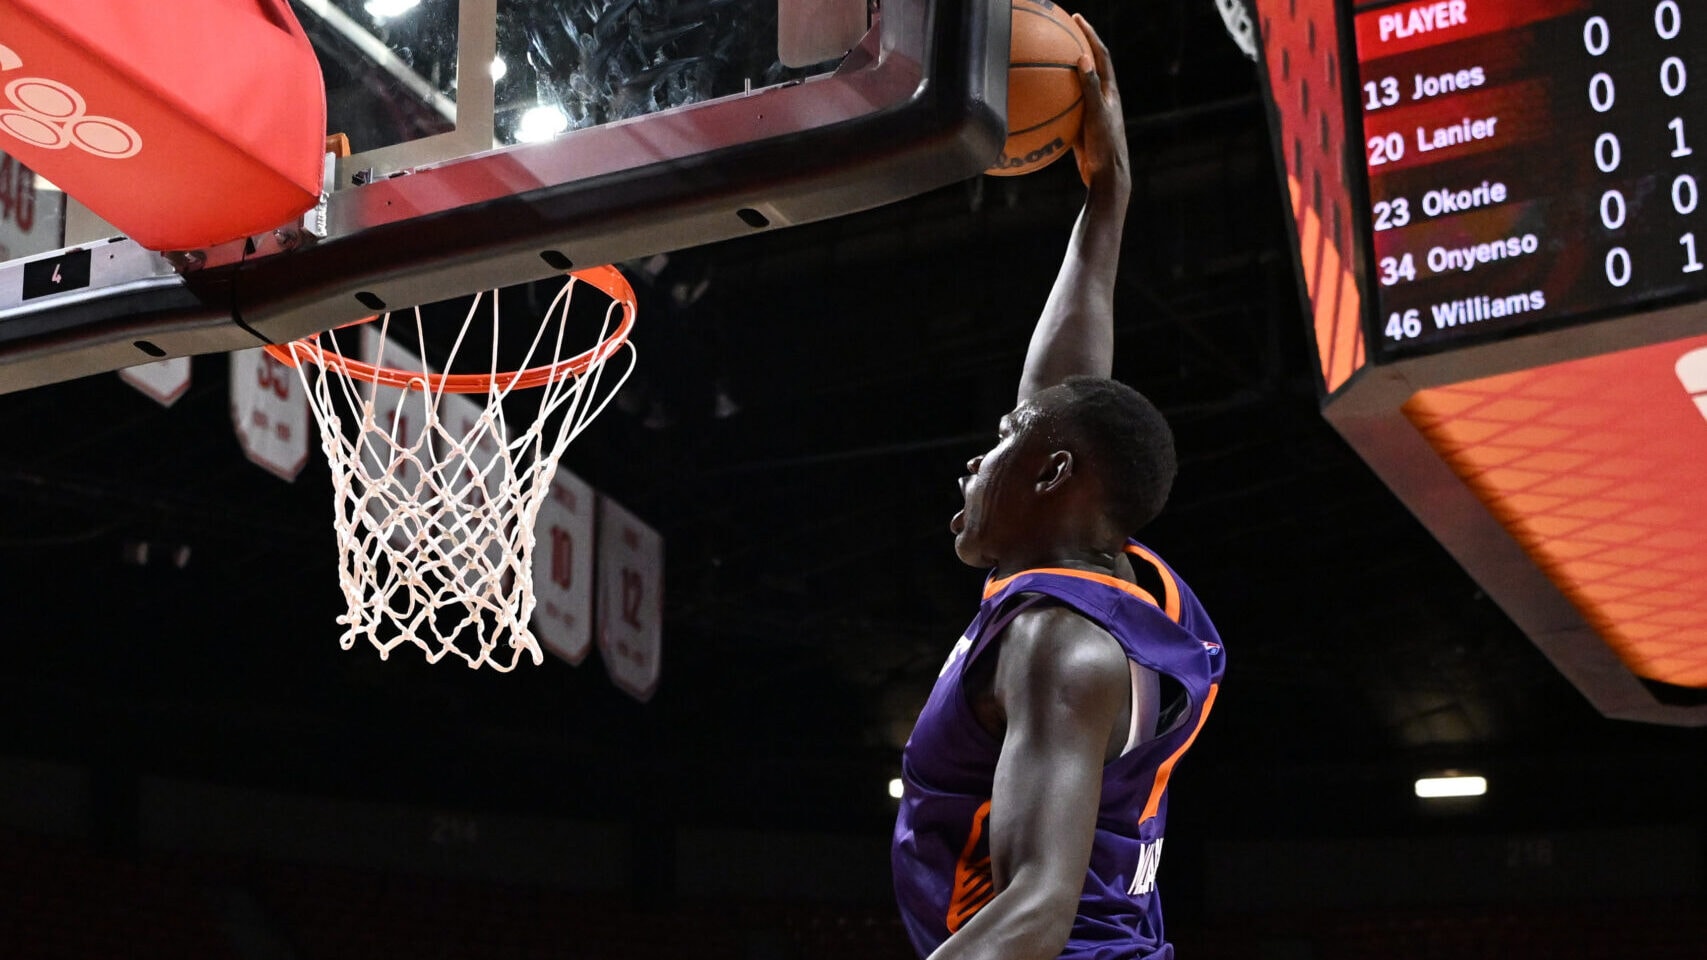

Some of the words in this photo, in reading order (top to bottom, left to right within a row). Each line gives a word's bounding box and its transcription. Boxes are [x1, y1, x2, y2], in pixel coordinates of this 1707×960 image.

[1363, 76, 1400, 110] 13
[1412, 66, 1486, 100] Jones
[1583, 16, 1610, 56] 0
[1654, 0, 1681, 40] 0
[1378, 0, 1468, 42] PLAYER
[1367, 132, 1404, 166] 20
[1416, 116, 1498, 152] Lanier
[1588, 72, 1615, 113] 0
[1659, 56, 1687, 97] 0
[1373, 197, 1411, 232] 23
[1422, 181, 1507, 217] Okorie
[1594, 132, 1621, 173] 0
[1668, 116, 1693, 158] 1
[1379, 252, 1416, 286] 34
[1427, 233, 1538, 273] Onyenso
[1600, 189, 1626, 230] 0
[1671, 174, 1698, 215] 0
[1385, 309, 1422, 341] 46
[1431, 290, 1546, 330] Williams
[1605, 247, 1632, 287] 0
[1679, 232, 1704, 273] 1
